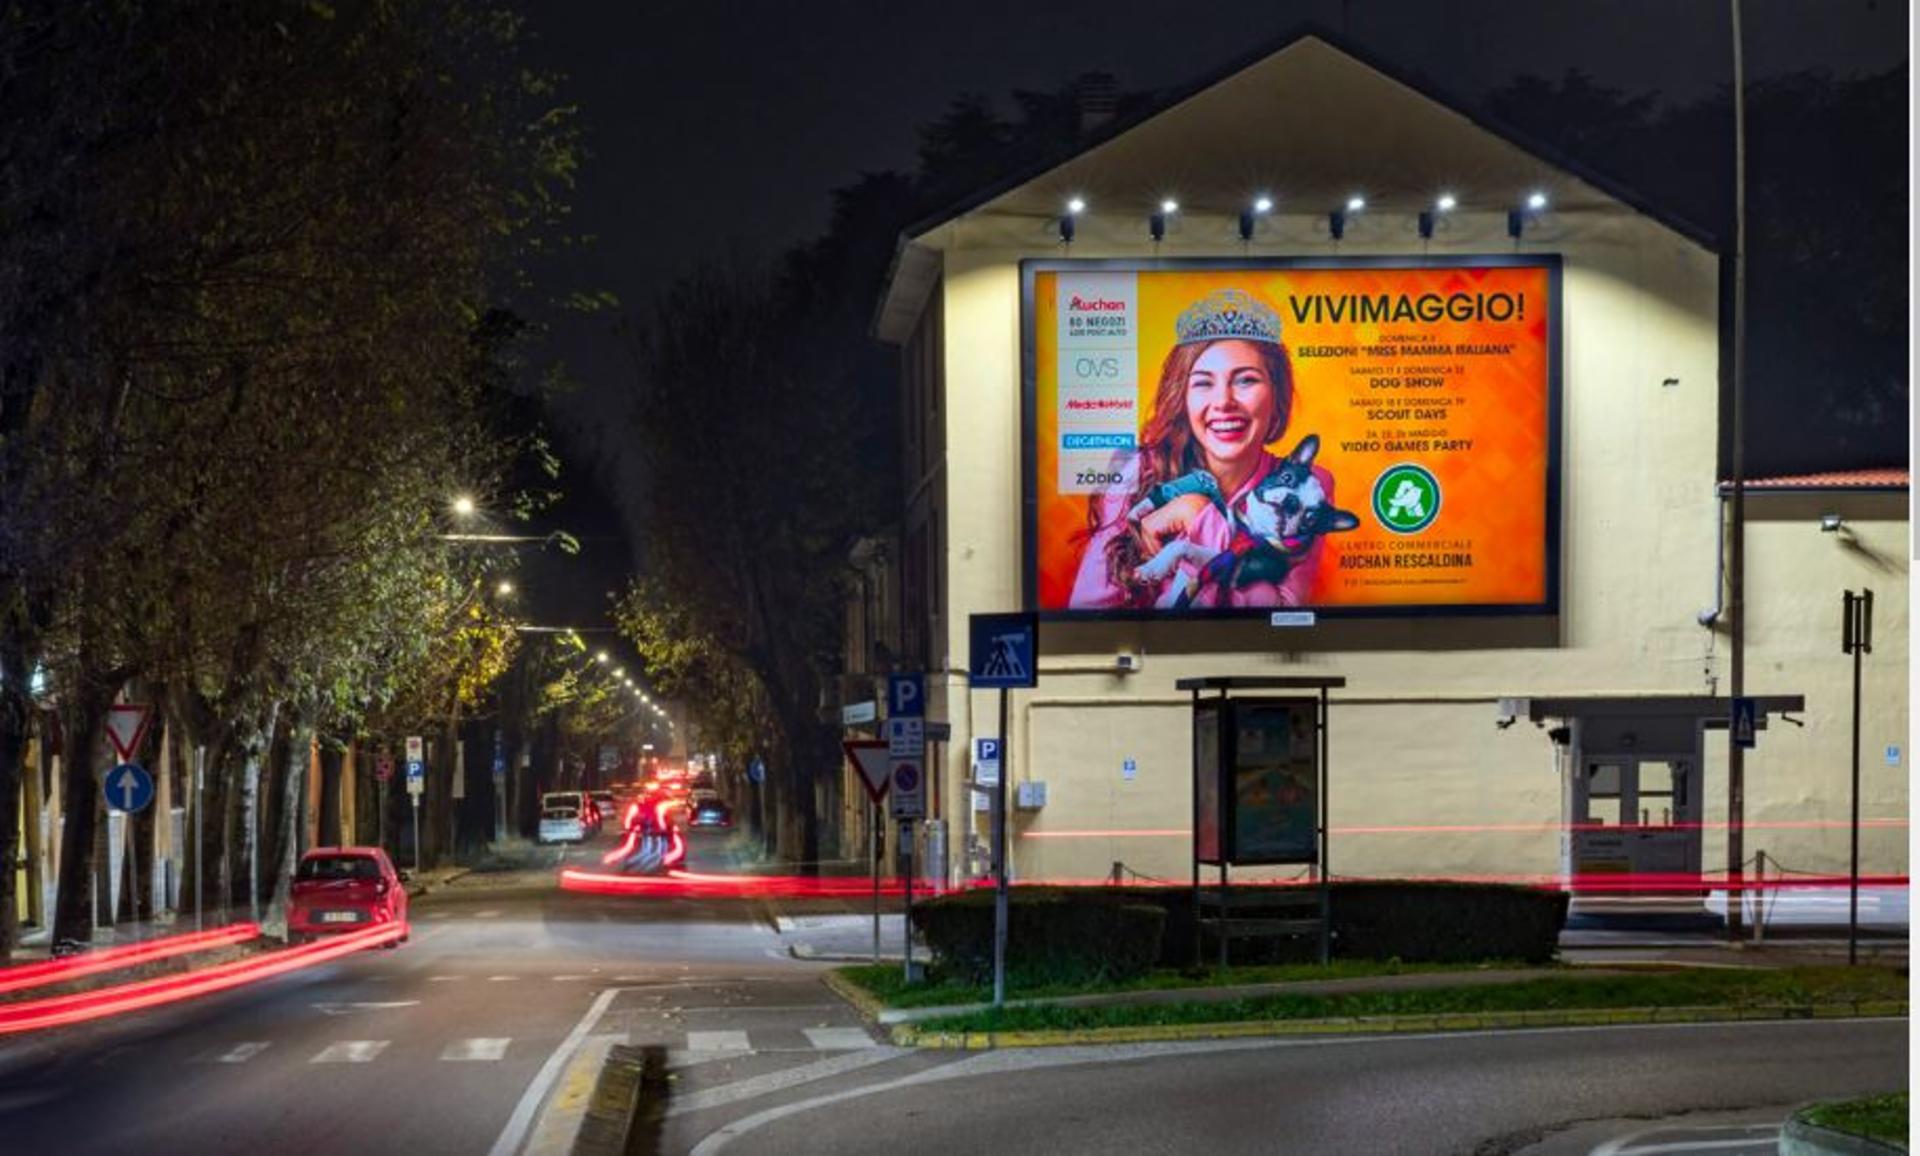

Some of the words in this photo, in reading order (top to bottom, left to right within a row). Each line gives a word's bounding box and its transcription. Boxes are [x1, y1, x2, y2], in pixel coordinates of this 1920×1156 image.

[1069, 295, 1126, 311] Auchan
[1289, 293, 1525, 323] VIVIMAGGIO!
[1400, 345, 1453, 356] MAMMA
[1075, 358, 1119, 378] OVS
[1370, 378, 1401, 389] DOG
[1405, 377, 1445, 388] SHOW
[1367, 410, 1410, 421] SCOUT
[1414, 409, 1447, 420] DAYS
[1065, 435, 1133, 447] DECATHLON
[1341, 441, 1381, 452] VIDEO
[1384, 440, 1430, 452] GAMES
[1432, 440, 1473, 451] PARTY
[1388, 540, 1473, 550] COMMERCIALE
[1340, 555, 1390, 569] AUCHAN
[1394, 553, 1473, 568] RESCALDINA
[896, 680, 918, 713] P
[982, 741, 996, 759] P
[409, 762, 420, 775] P
